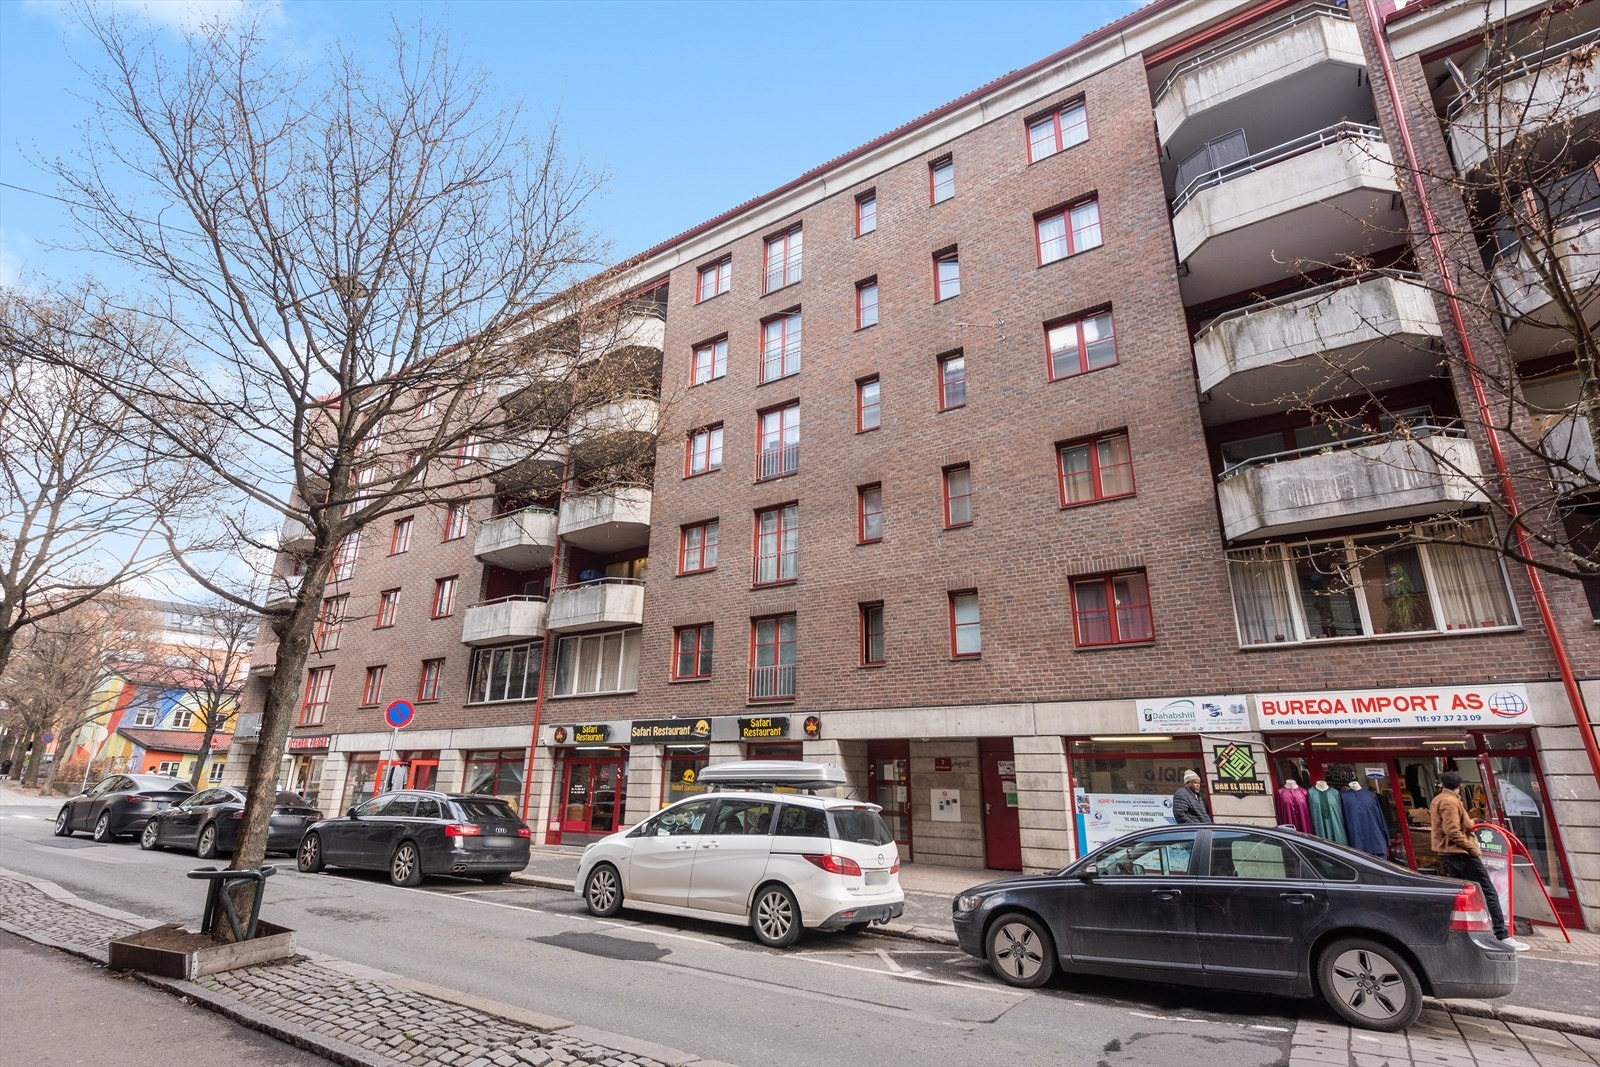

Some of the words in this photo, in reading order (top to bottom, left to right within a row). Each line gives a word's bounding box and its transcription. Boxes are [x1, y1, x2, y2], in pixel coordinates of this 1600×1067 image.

[1261, 699, 1348, 716] BUREQA
[1351, 695, 1440, 714] IMPORT
[1451, 693, 1484, 711] AS
[1152, 711, 1196, 720] Dahabshiil
[1414, 715, 1430, 723] Tlf:
[750, 718, 772, 728] Safari
[1297, 717, 1401, 726] bureqaimport@gmail.com
[582, 725, 598, 734] Safari
[631, 726, 652, 737] Safari
[653, 725, 691, 736] Restaurant
[743, 727, 782, 738] Restaurant
[575, 733, 605, 742] Restaurant
[1239, 783, 1264, 791] HIDJAZ
